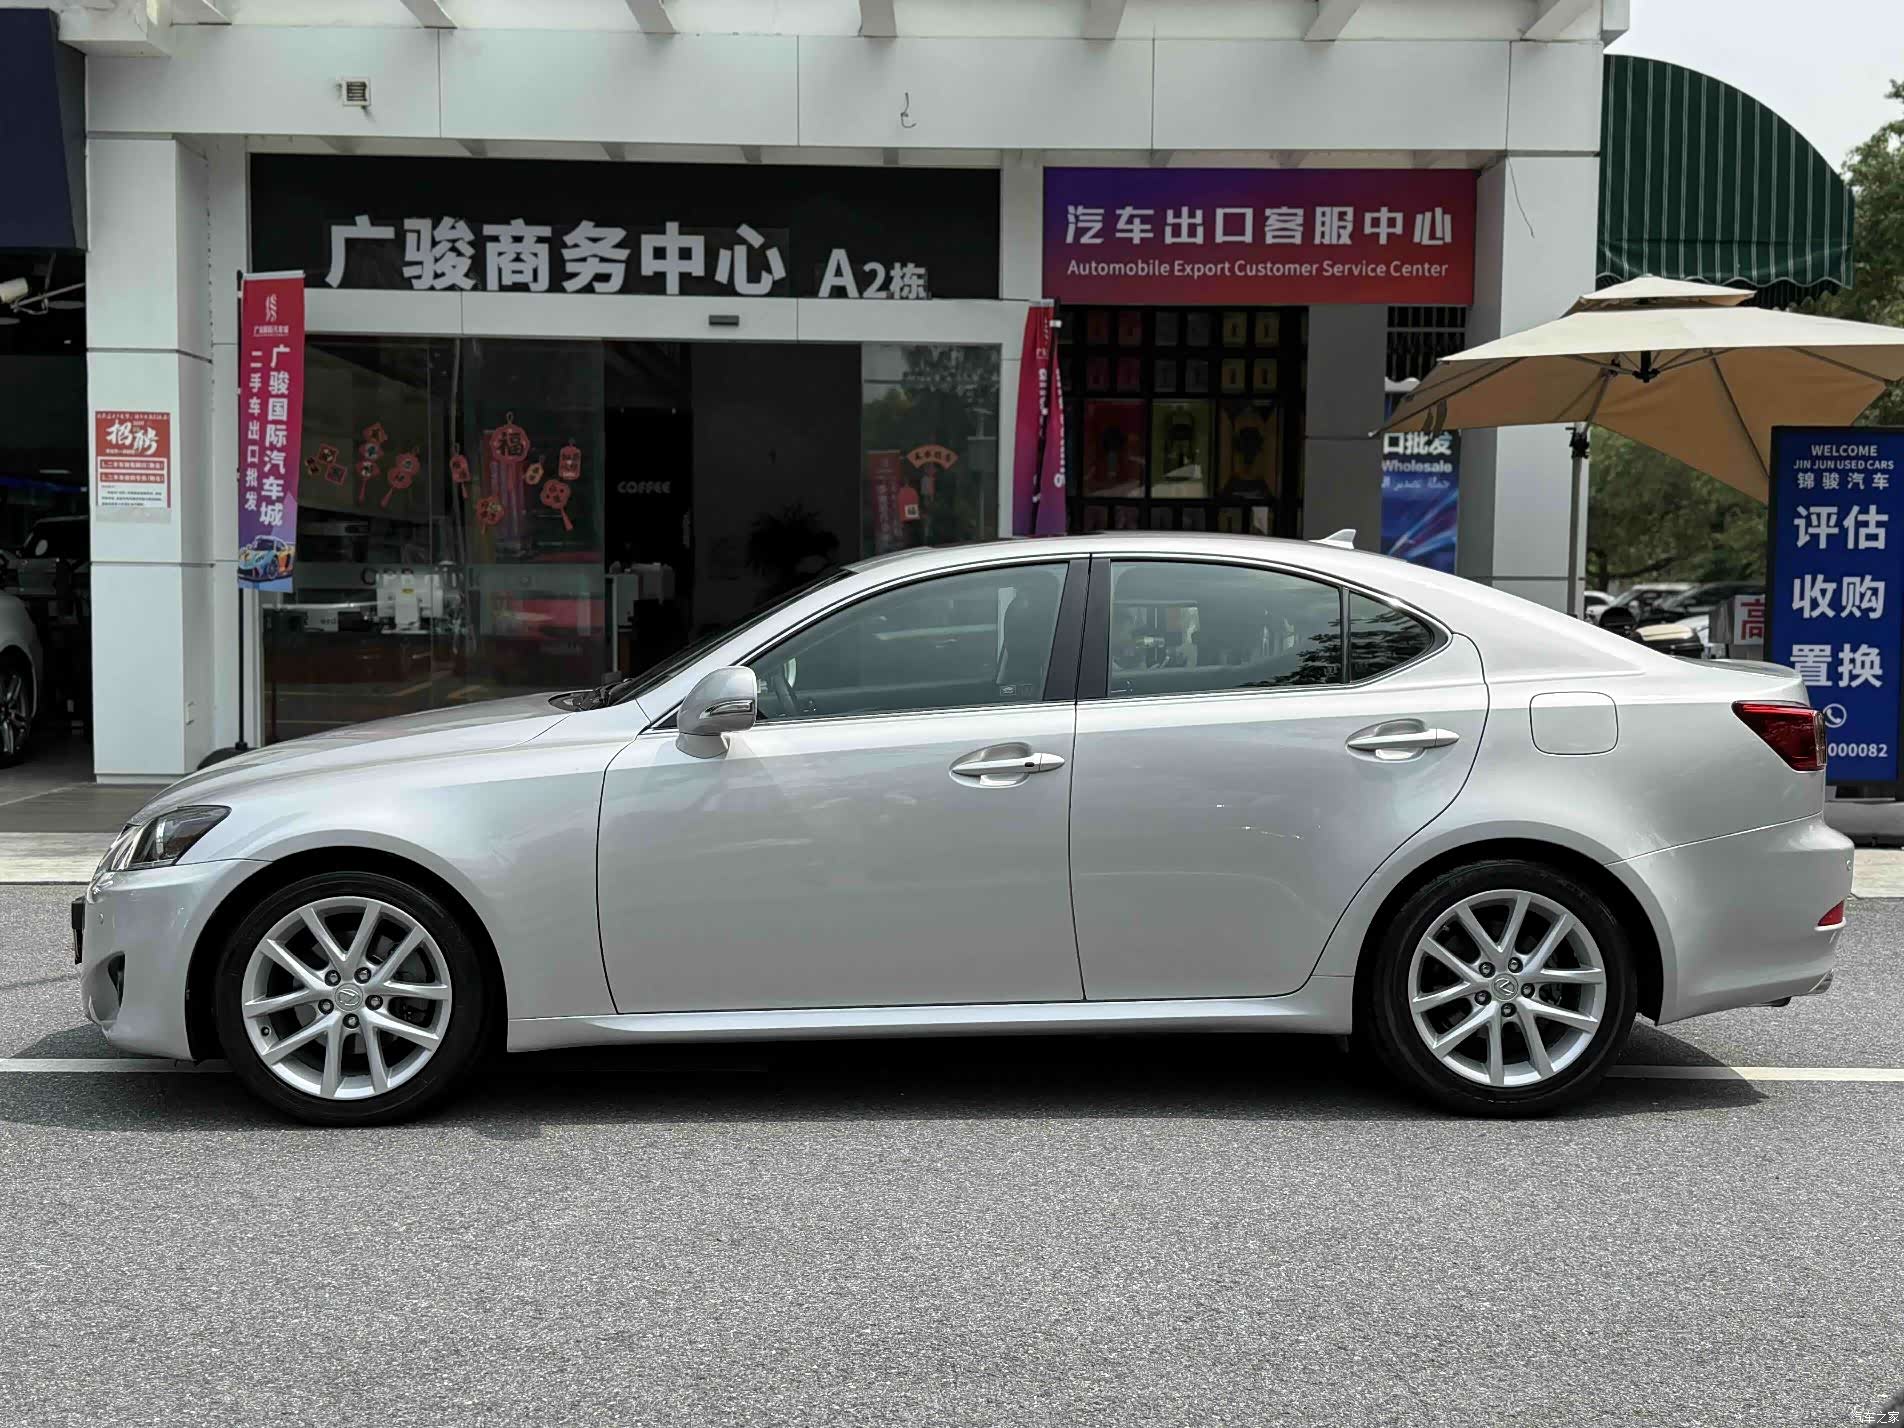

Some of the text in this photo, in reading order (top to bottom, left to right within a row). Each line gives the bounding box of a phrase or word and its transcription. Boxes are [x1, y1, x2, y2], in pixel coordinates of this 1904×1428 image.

[1065, 205, 1453, 246] 汽车出口客服中心
[325, 215, 929, 300] 广骏商务中心 A2栋
[1067, 260, 1449, 279] Automobile Export Customer Service Center
[106, 419, 159, 455] 招聘
[244, 350, 263, 511] 二手车出口批发
[259, 344, 291, 526] 广骏国际汽车城
[1382, 460, 1453, 473] Wholesale
[1793, 459, 1895, 470] JIN JUN USED CARS
[1811, 444, 1878, 457] WELCOME
[617, 481, 671, 494] COFFEE
[1797, 472, 1889, 490] 锦骏汽车
[1793, 505, 1889, 550] 评估
[1791, 574, 1886, 620] 收购
[1741, 598, 1765, 641] 高
[1790, 643, 1883, 688] 置换
[1828, 743, 1888, 758] 000082
